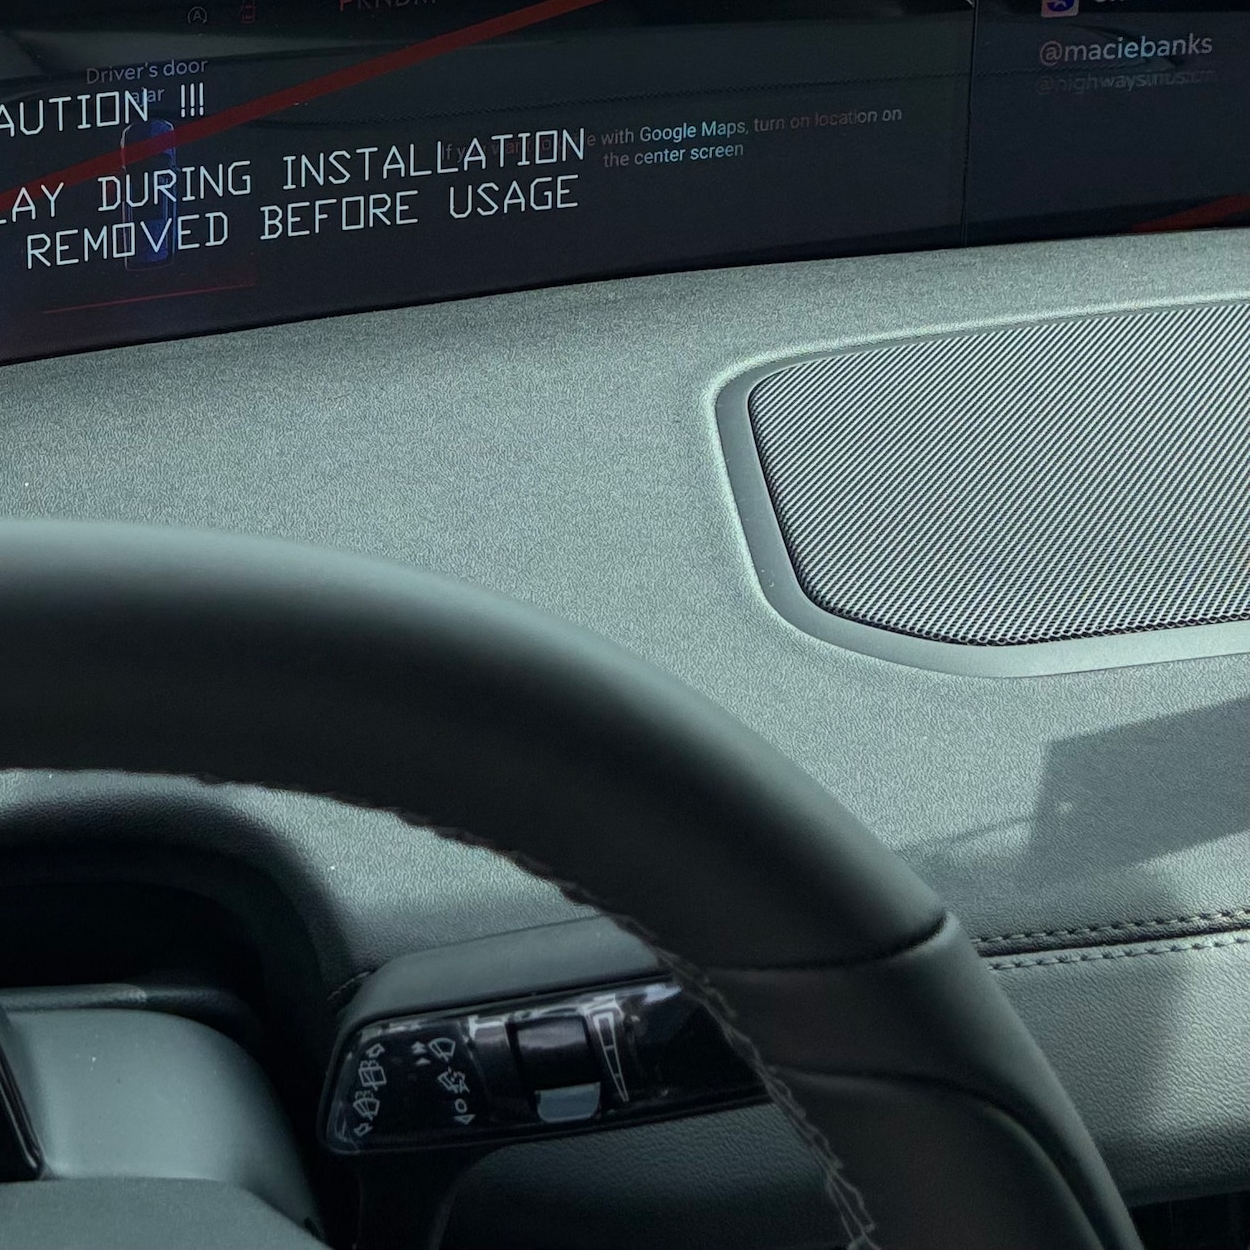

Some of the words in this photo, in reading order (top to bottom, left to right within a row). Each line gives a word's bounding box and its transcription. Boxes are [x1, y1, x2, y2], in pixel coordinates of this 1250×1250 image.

[1039, 32, 1213, 67] @maciebanks
[85, 62, 158, 85] Driver's
[163, 58, 209, 77] door
[601, 127, 635, 146] with
[639, 122, 698, 144] Google
[701, 121, 749, 138] Maps,
[754, 118, 785, 132] turn
[790, 115, 810, 129] on
[814, 110, 878, 127] location
[882, 108, 903, 122] on
[97, 160, 251, 212] DURING
[283, 128, 584, 190] INSTALLATION
[603, 152, 630, 168] the
[634, 147, 686, 166] center
[690, 143, 744, 161] screen
[27, 211, 228, 269] REMOVED
[260, 190, 418, 240] BEFORE
[450, 174, 579, 219] USAGE
